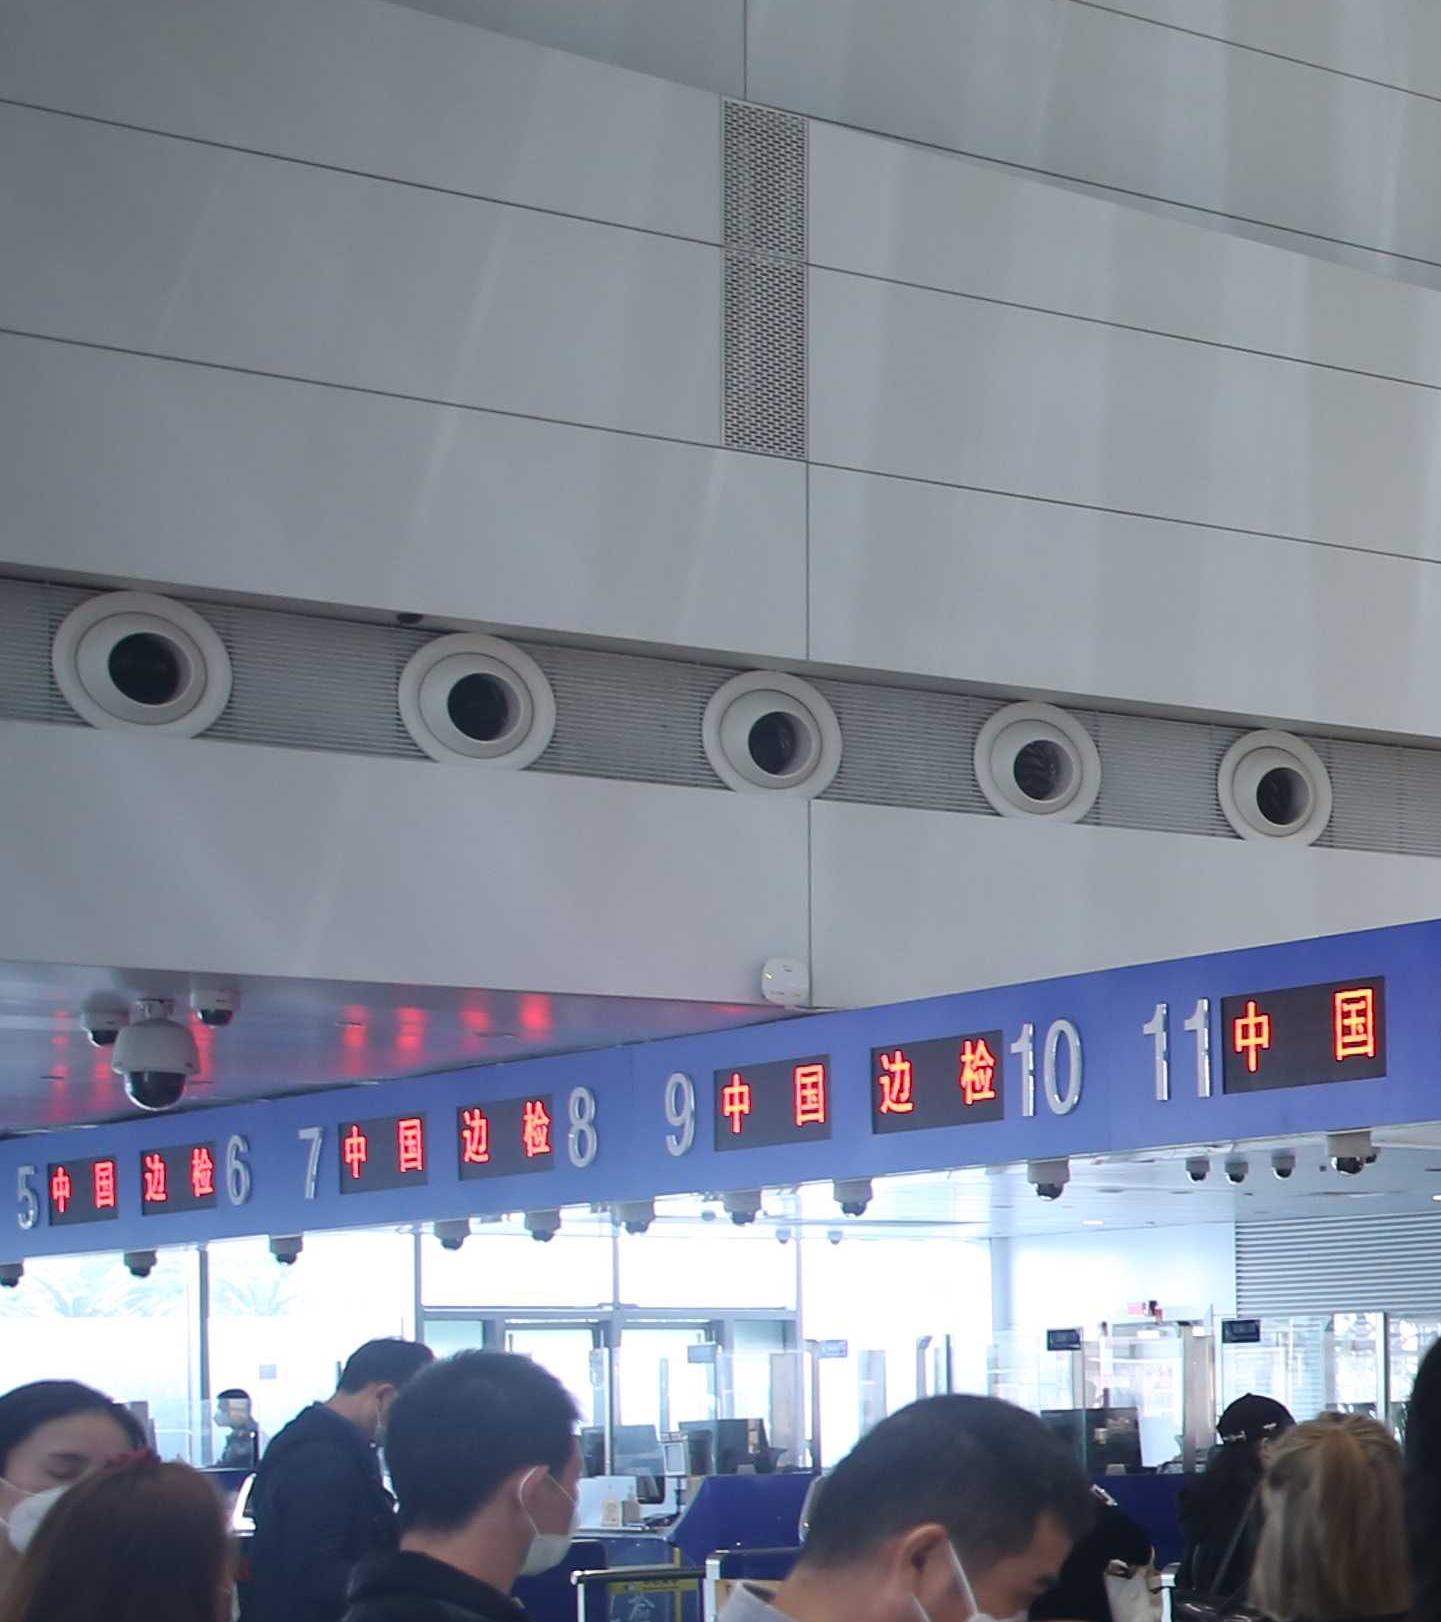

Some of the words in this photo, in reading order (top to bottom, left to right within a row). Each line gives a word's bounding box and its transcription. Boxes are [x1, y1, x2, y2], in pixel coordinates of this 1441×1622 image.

[1143, 998, 1210, 1101] 11
[1232, 987, 1377, 1072] 中国
[721, 1062, 827, 1134] 中国
[878, 1039, 997, 1114] 边检
[1010, 1019, 1082, 1117] 10
[342, 1116, 426, 1179] 中国
[461, 1100, 552, 1164] 边检
[567, 1086, 599, 1168] 8
[664, 1072, 696, 1157] 9
[16, 1166, 38, 1230] 5
[50, 1160, 116, 1213] 中国
[143, 1146, 214, 1203] 边检
[223, 1135, 251, 1205] 6
[297, 1127, 323, 1199] 7
